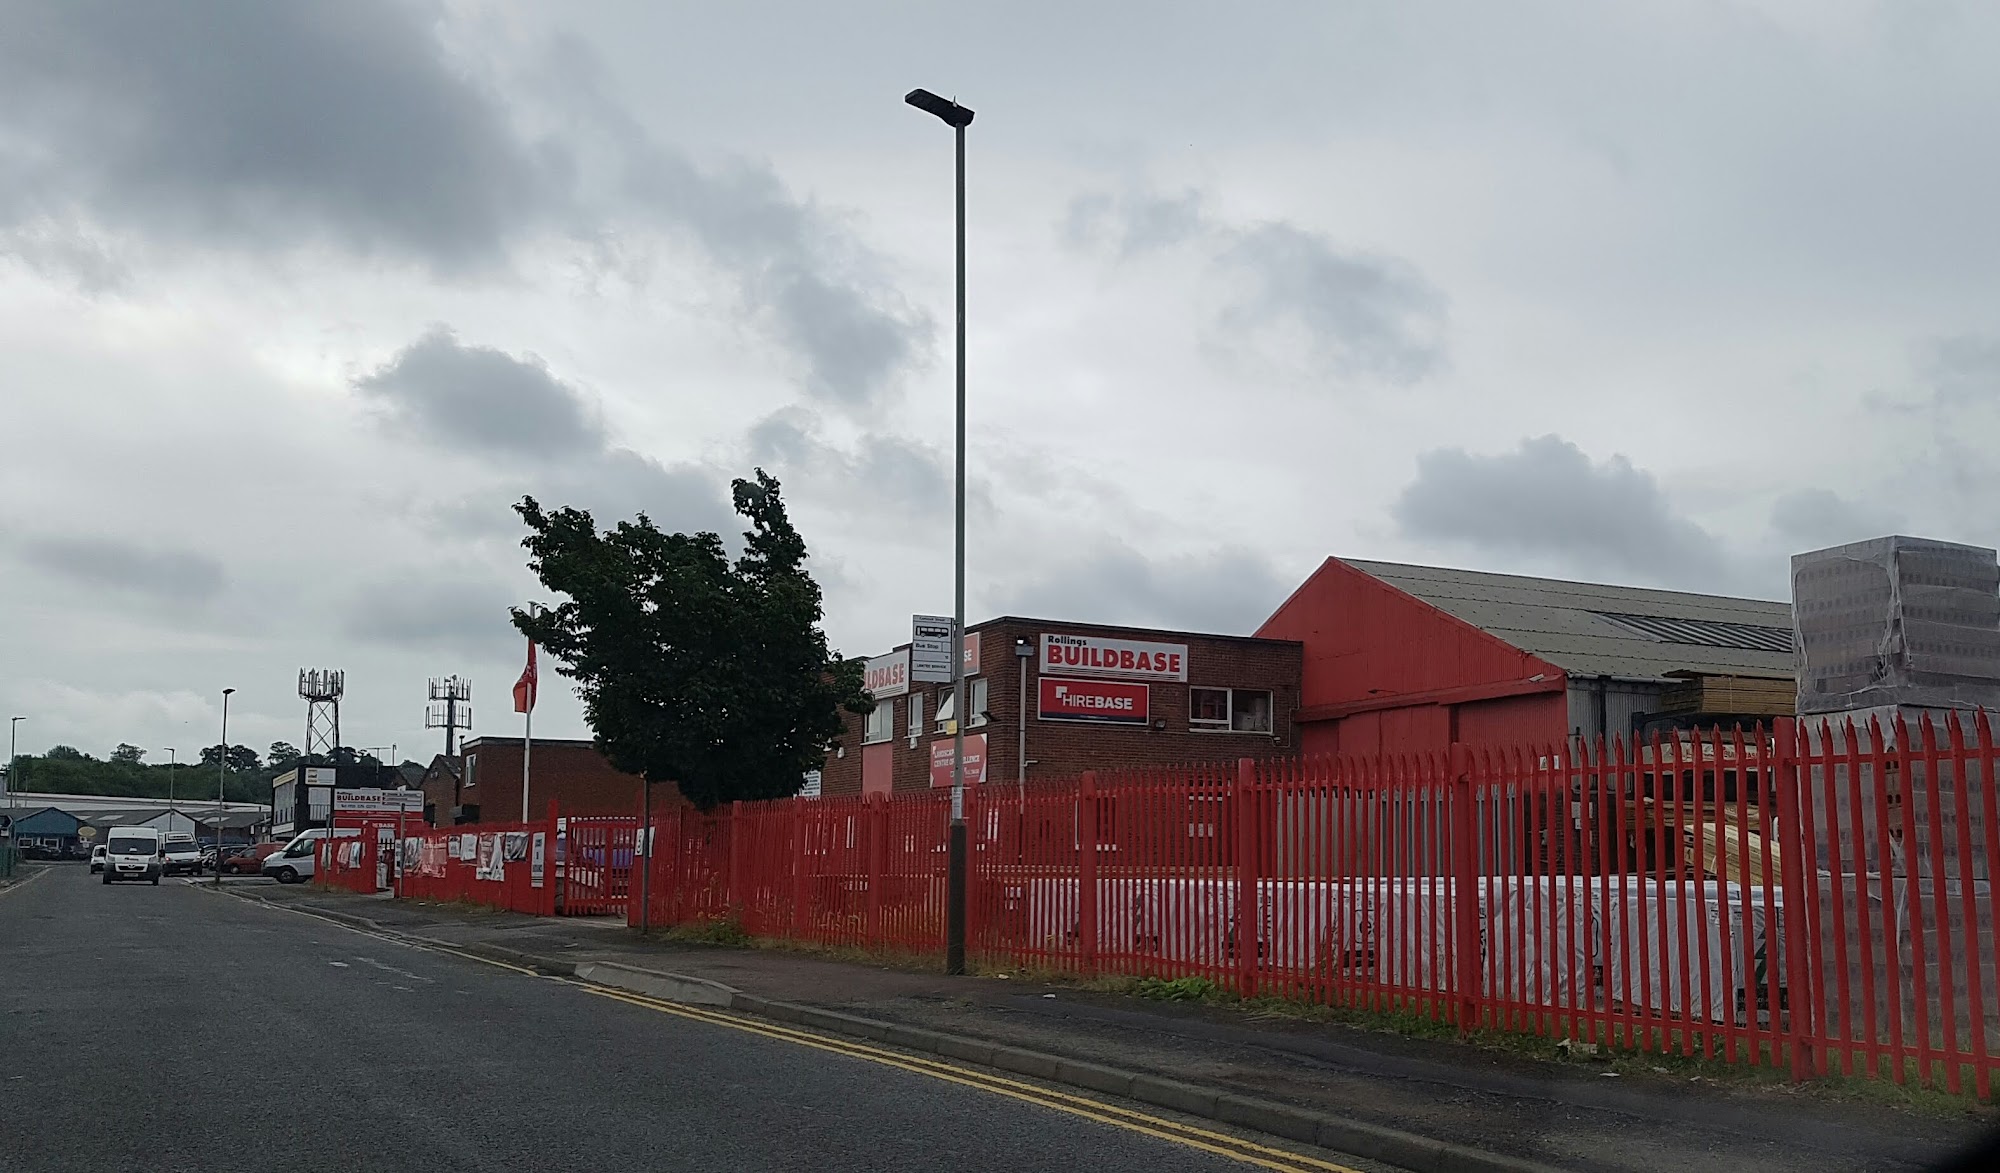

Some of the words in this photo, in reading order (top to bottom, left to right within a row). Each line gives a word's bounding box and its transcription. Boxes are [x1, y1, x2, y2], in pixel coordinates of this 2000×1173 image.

[1048, 635, 1087, 647] Rollings
[1048, 645, 1180, 672] BUILDBASE
[1062, 693, 1133, 710] HIREBASE
